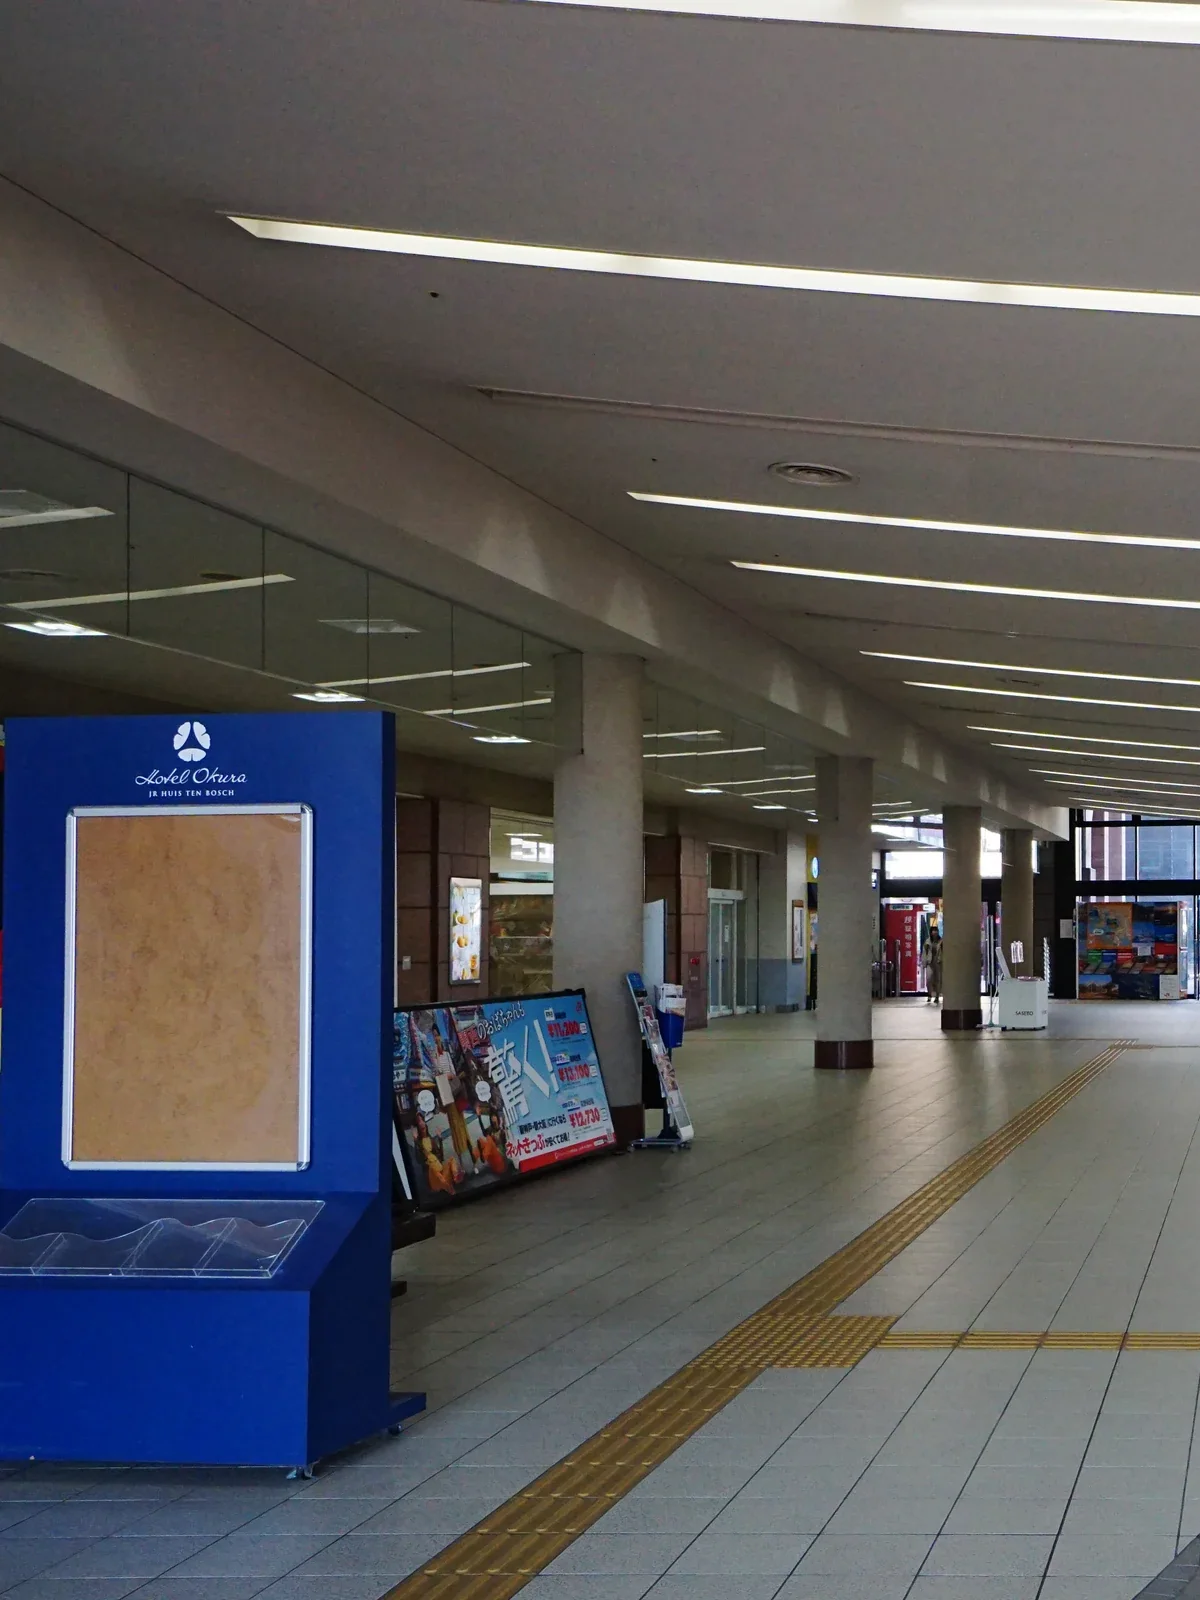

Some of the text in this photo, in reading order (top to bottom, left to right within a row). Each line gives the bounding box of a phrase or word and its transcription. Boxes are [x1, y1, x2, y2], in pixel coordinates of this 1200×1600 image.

[135, 767, 247, 785] Hotel Okura
[205, 789, 235, 797] BOSCH
